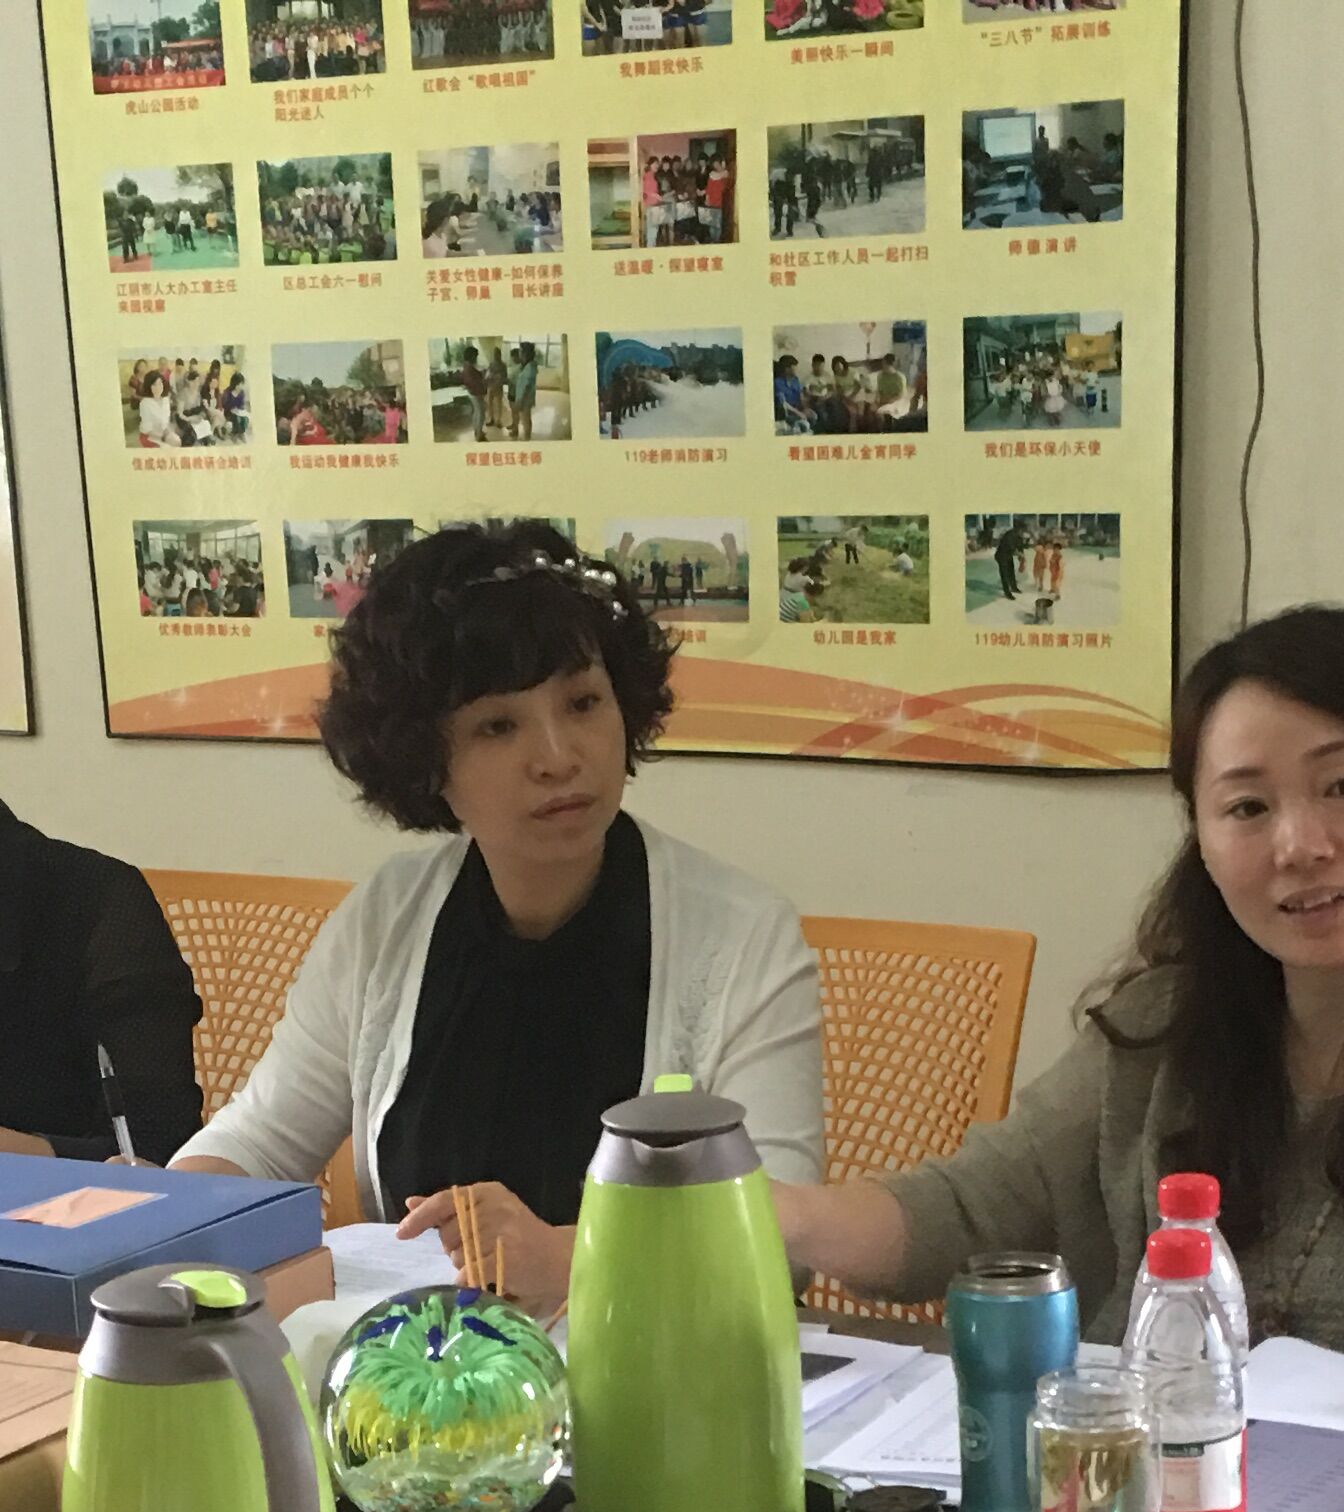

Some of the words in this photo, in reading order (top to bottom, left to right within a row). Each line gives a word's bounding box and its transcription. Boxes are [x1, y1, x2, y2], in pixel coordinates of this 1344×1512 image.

[790, 40, 894, 65] 美丽快乐一瞬间
[619, 56, 704, 79] 我舞蹈我快乐
[274, 83, 375, 105] 我们家庭成员个个
[125, 96, 200, 115] 虎山公园活动
[769, 246, 929, 267] 和社区工作人员一起打扫
[283, 272, 383, 291] 区总工会六一慰问
[625, 448, 727, 464] 119老师消防演习
[984, 440, 1101, 458] 我们是环保小天使
[289, 453, 400, 470] 我运动我健康我快乐
[813, 630, 897, 645] 幼儿园是我家
[975, 632, 1113, 648] 119幼儿消防演习照片
